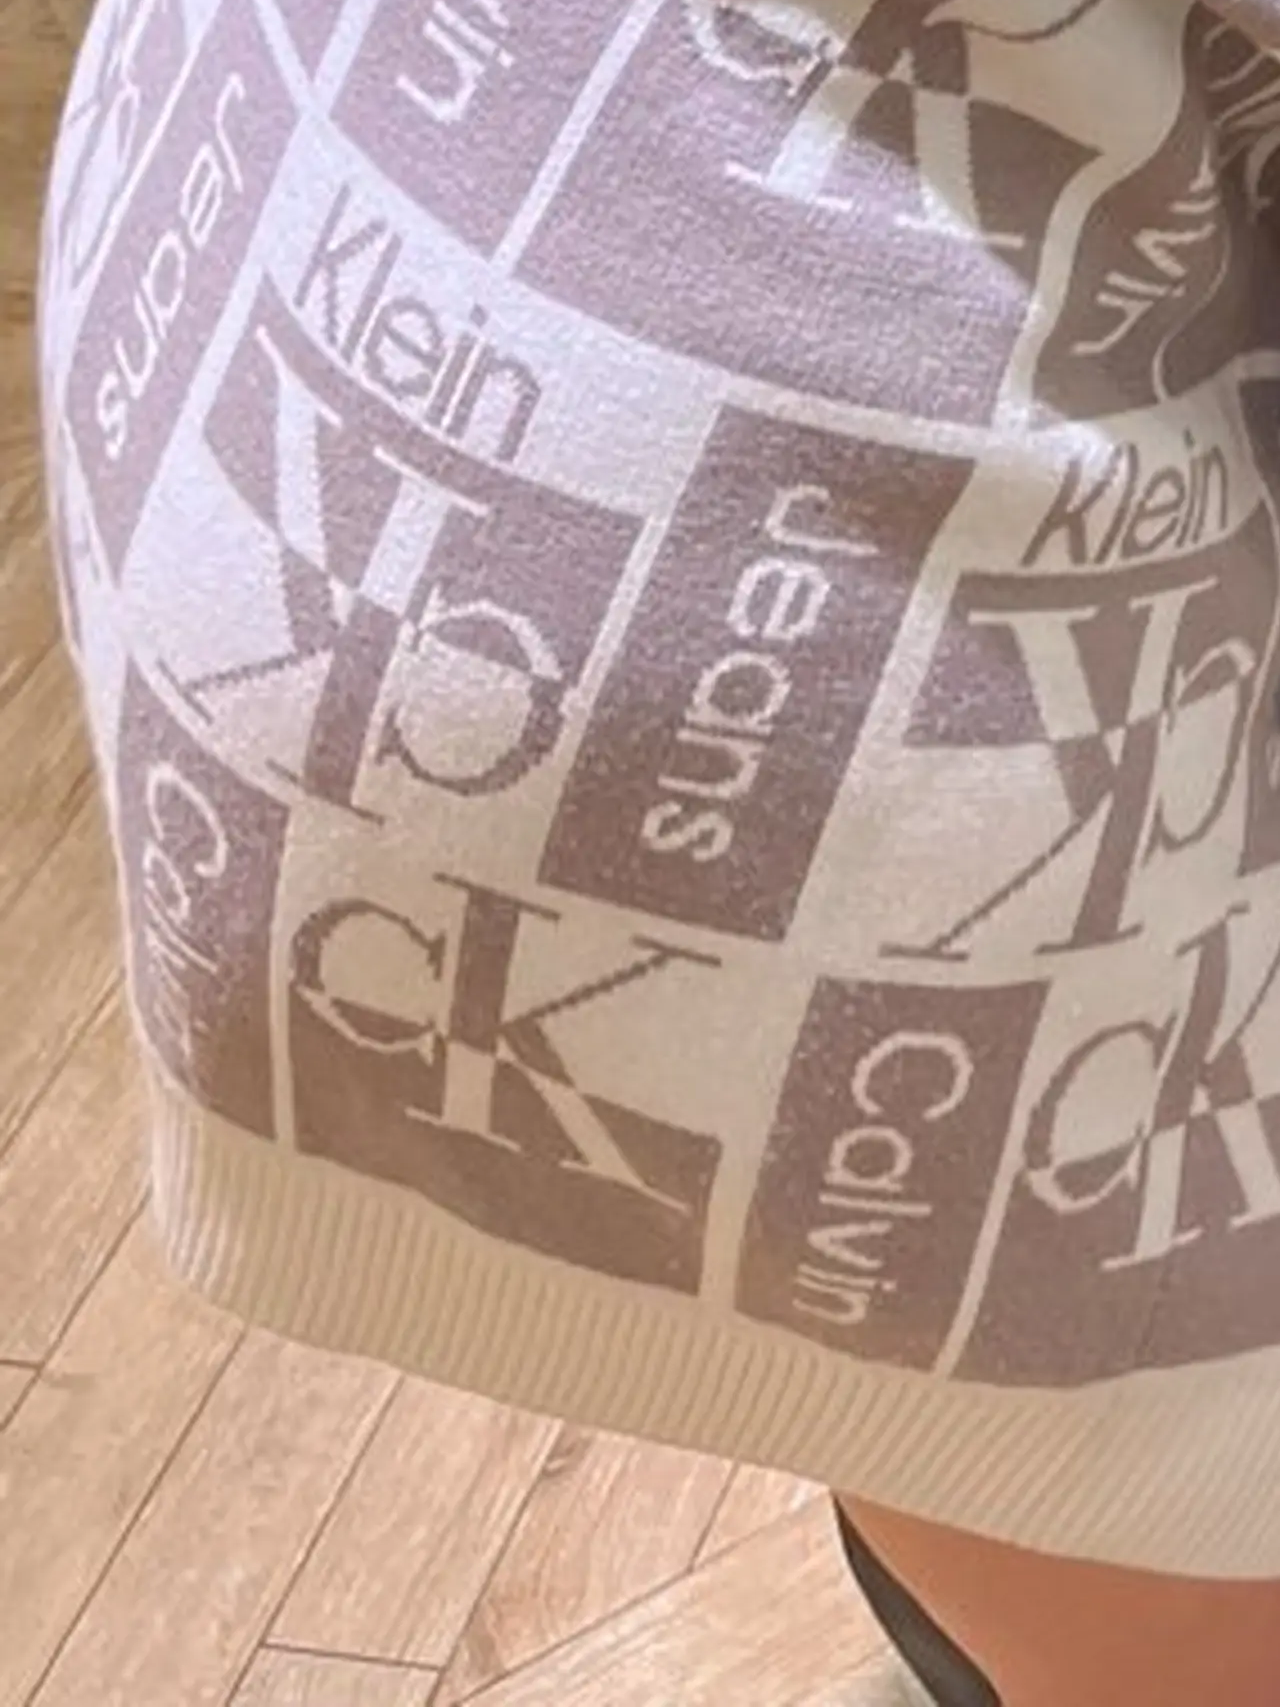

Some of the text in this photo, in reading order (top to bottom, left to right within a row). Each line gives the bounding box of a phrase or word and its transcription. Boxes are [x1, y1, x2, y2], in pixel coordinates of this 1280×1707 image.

[96, 72, 247, 461] Jeans
[292, 183, 544, 466] Klein
[1021, 432, 1227, 567] Klein
[641, 480, 879, 866] Jeans
[793, 1030, 975, 1326] Calvin
